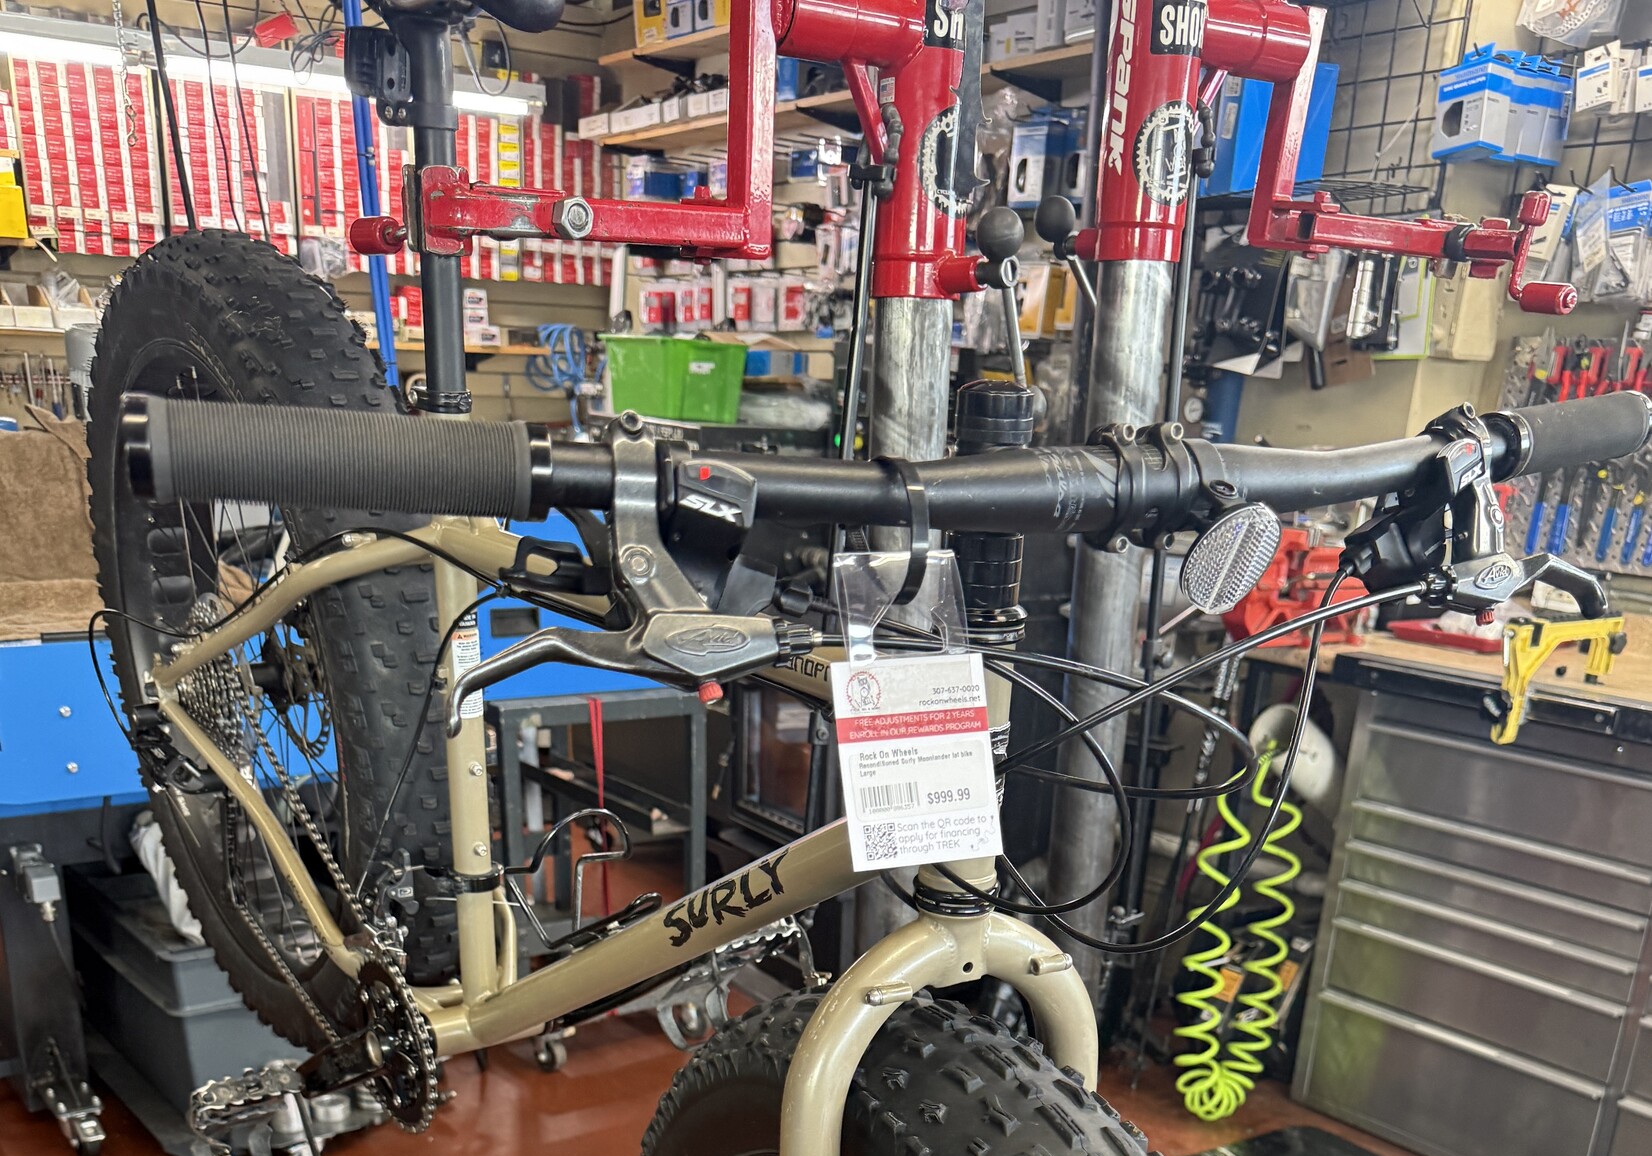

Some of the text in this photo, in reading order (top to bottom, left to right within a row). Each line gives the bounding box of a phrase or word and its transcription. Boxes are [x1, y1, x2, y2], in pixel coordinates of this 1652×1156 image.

[1460, 462, 1482, 490] SLX
[679, 494, 743, 523] SLX
[919, 695, 981, 707] rockonwheels.net
[854, 709, 975, 727] FREE ADJUSTMENTS FOR 2 YEARS
[849, 720, 981, 740] ENROLL IN OUR REWARDS PROGRAM
[859, 747, 918, 761] Rock On Wheels
[917, 753, 951, 763] Moonlander
[860, 770, 876, 778] Large
[927, 787, 971, 805] $999.99
[897, 815, 987, 833] Scan the QR code to
[898, 826, 981, 844] apply for financing
[899, 839, 960, 855] through TREK
[663, 848, 790, 947] SURLY
